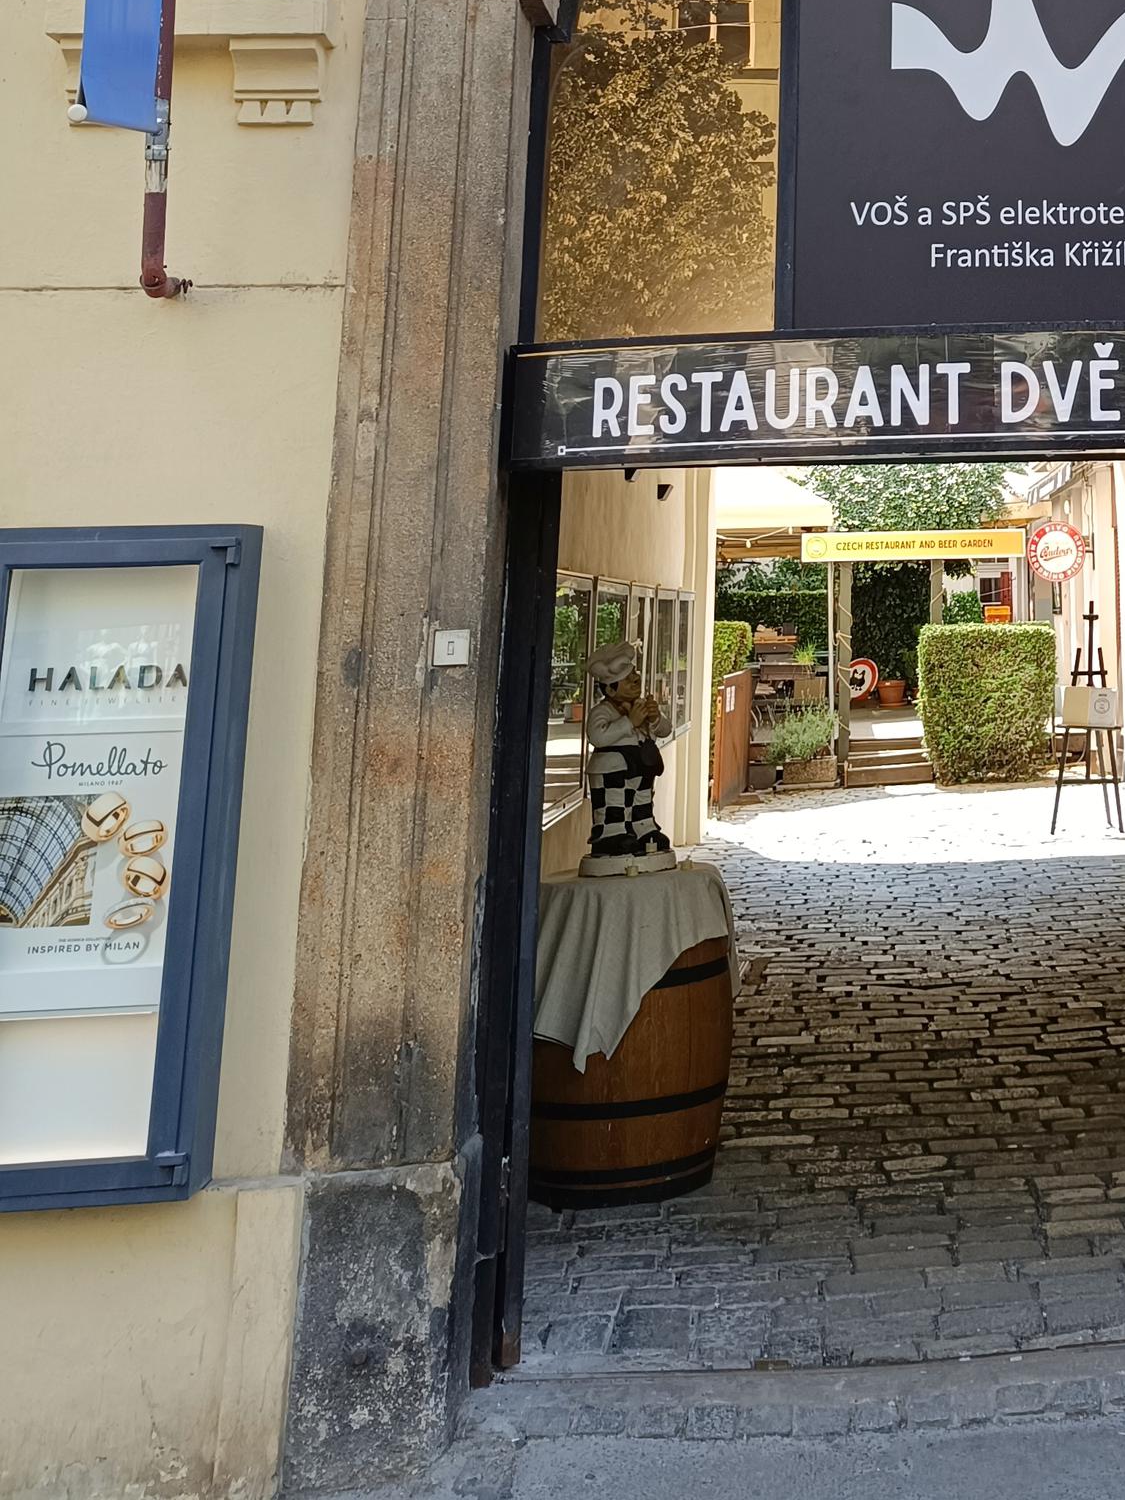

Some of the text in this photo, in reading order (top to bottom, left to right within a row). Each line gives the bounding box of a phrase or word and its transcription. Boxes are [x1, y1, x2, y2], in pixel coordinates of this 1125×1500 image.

[850, 195, 909, 226] VOŠ
[917, 207, 932, 226] a
[941, 195, 992, 226] SPŠ
[930, 242, 1055, 268] Františka
[592, 362, 972, 438] RESTAURANT
[1000, 342, 1121, 424] DVĚ
[836, 538, 994, 551] CZECH RESTAURANT AND BEER GARDEN
[28, 663, 188, 692] HALADA
[31, 741, 168, 780] Pomellato
[27, 942, 140, 954] INSPIRED BY MILAN
